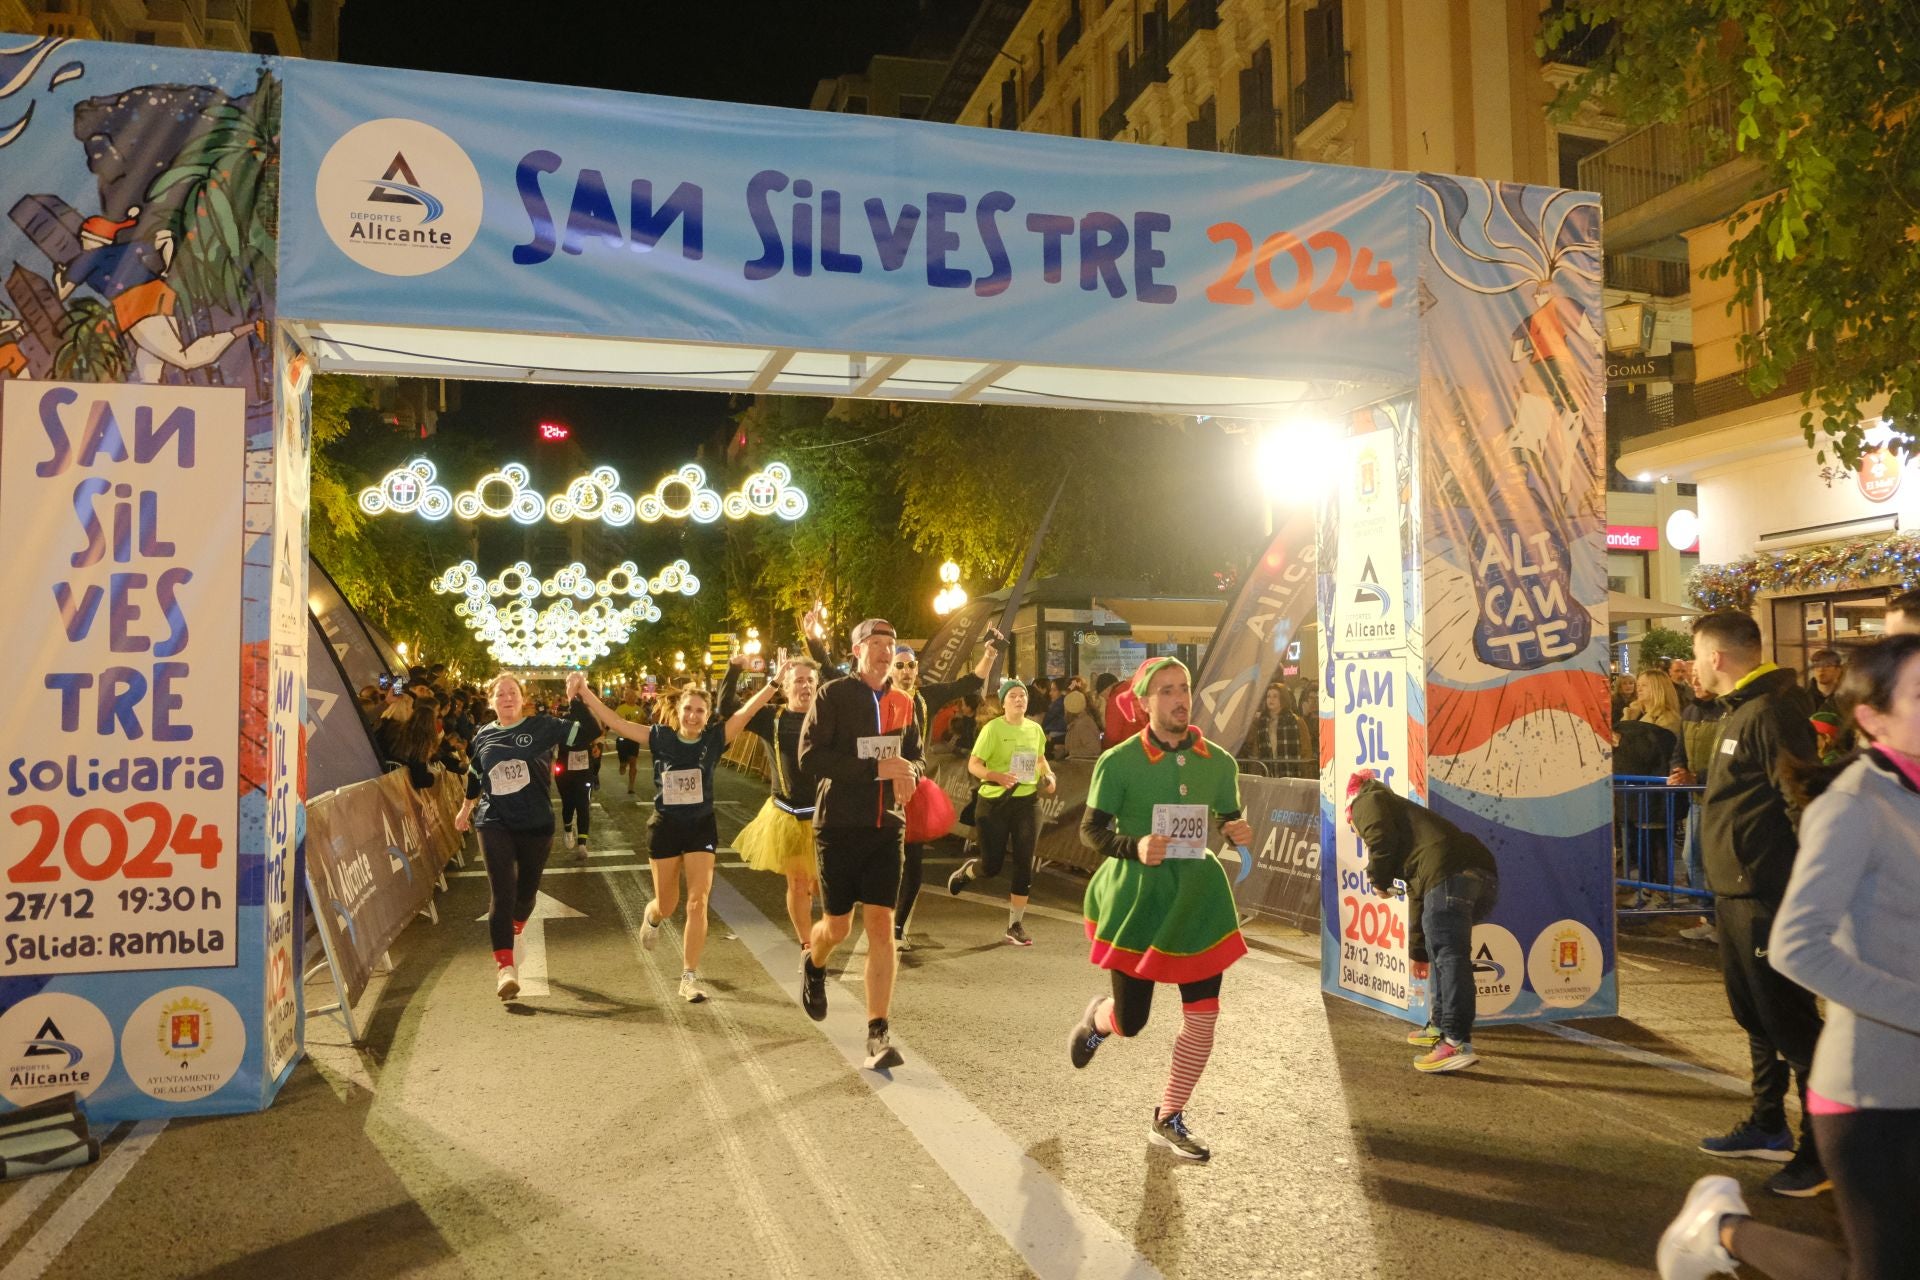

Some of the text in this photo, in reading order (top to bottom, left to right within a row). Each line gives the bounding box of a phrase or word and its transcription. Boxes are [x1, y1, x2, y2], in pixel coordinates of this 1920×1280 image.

[350, 211, 402, 223] DEPORTES
[350, 221, 452, 245] Alicante
[513, 149, 703, 265] SAN
[1206, 221, 1397, 313] 2024
[36, 387, 195, 478] SAN
[1478, 531, 1558, 577] ALI
[52, 567, 193, 658] VES
[1485, 580, 1567, 627] CAN
[1345, 621, 1396, 638] Alicante
[1486, 620, 1576, 664] TE
[45, 662, 193, 742] TRE
[1344, 663, 1394, 714] SAN
[504, 765, 524, 780] 632
[678, 777, 696, 791] 738
[7, 801, 223, 883] 2024
[1171, 817, 1203, 839] 2298
[4, 886, 222, 922] 27/12 19:30 h
[1344, 896, 1405, 949] 2024
[5, 928, 224, 965] Salida: Rambla
[1344, 943, 1406, 974] 27/12 19:30 h
[1343, 966, 1405, 999] Salida: Rambla
[10, 1070, 90, 1087] Alicante
[146, 1072, 220, 1084] AYUNTAMIENTO
[153, 1084, 214, 1095] DE ALICANTE
